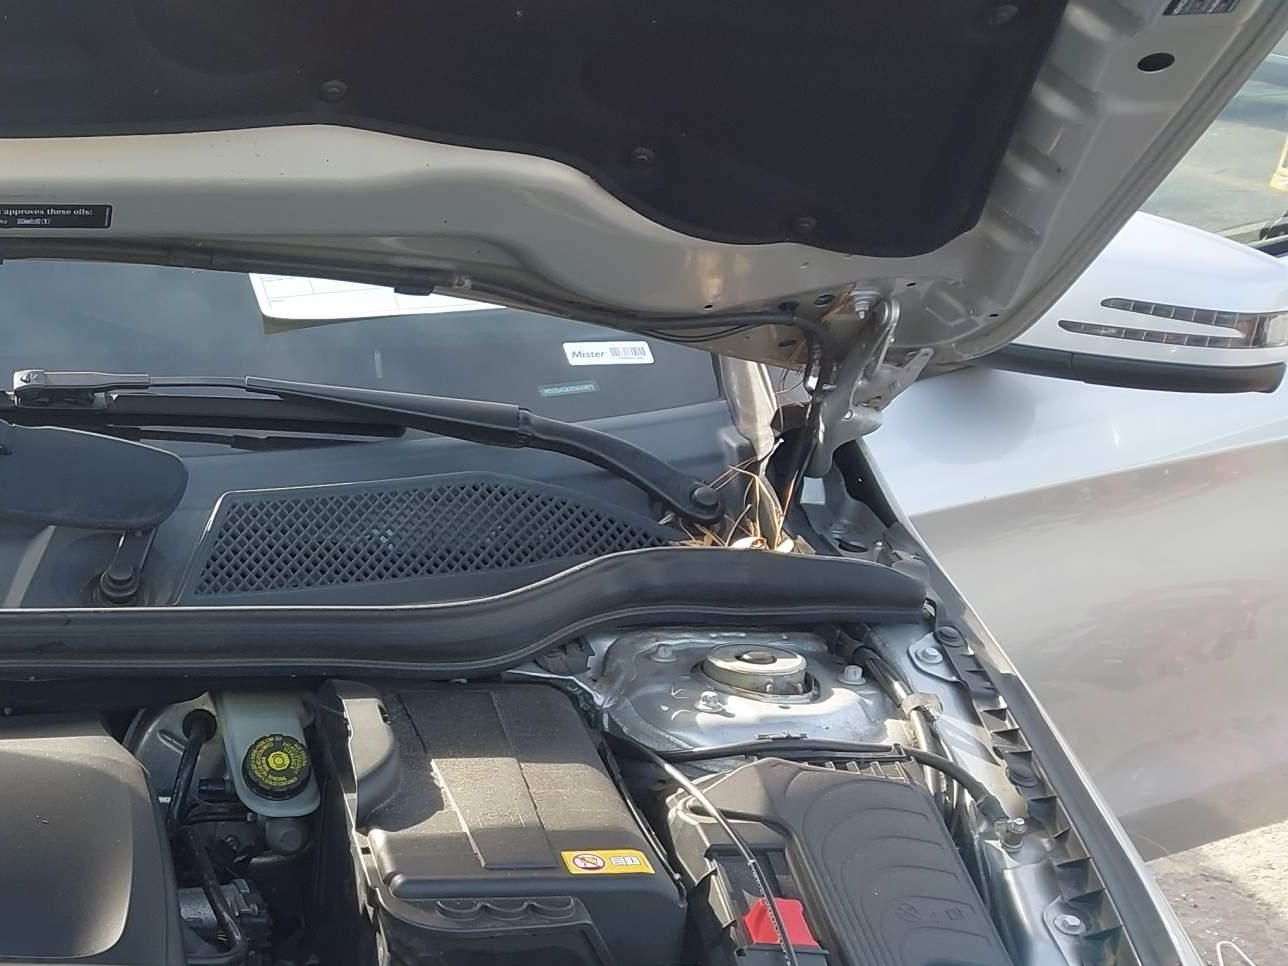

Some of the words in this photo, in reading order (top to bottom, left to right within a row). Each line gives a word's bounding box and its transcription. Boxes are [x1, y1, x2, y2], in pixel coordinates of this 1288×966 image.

[4, 208, 44, 216] approves
[47, 207, 72, 215] these
[572, 350, 604, 358] Mister
